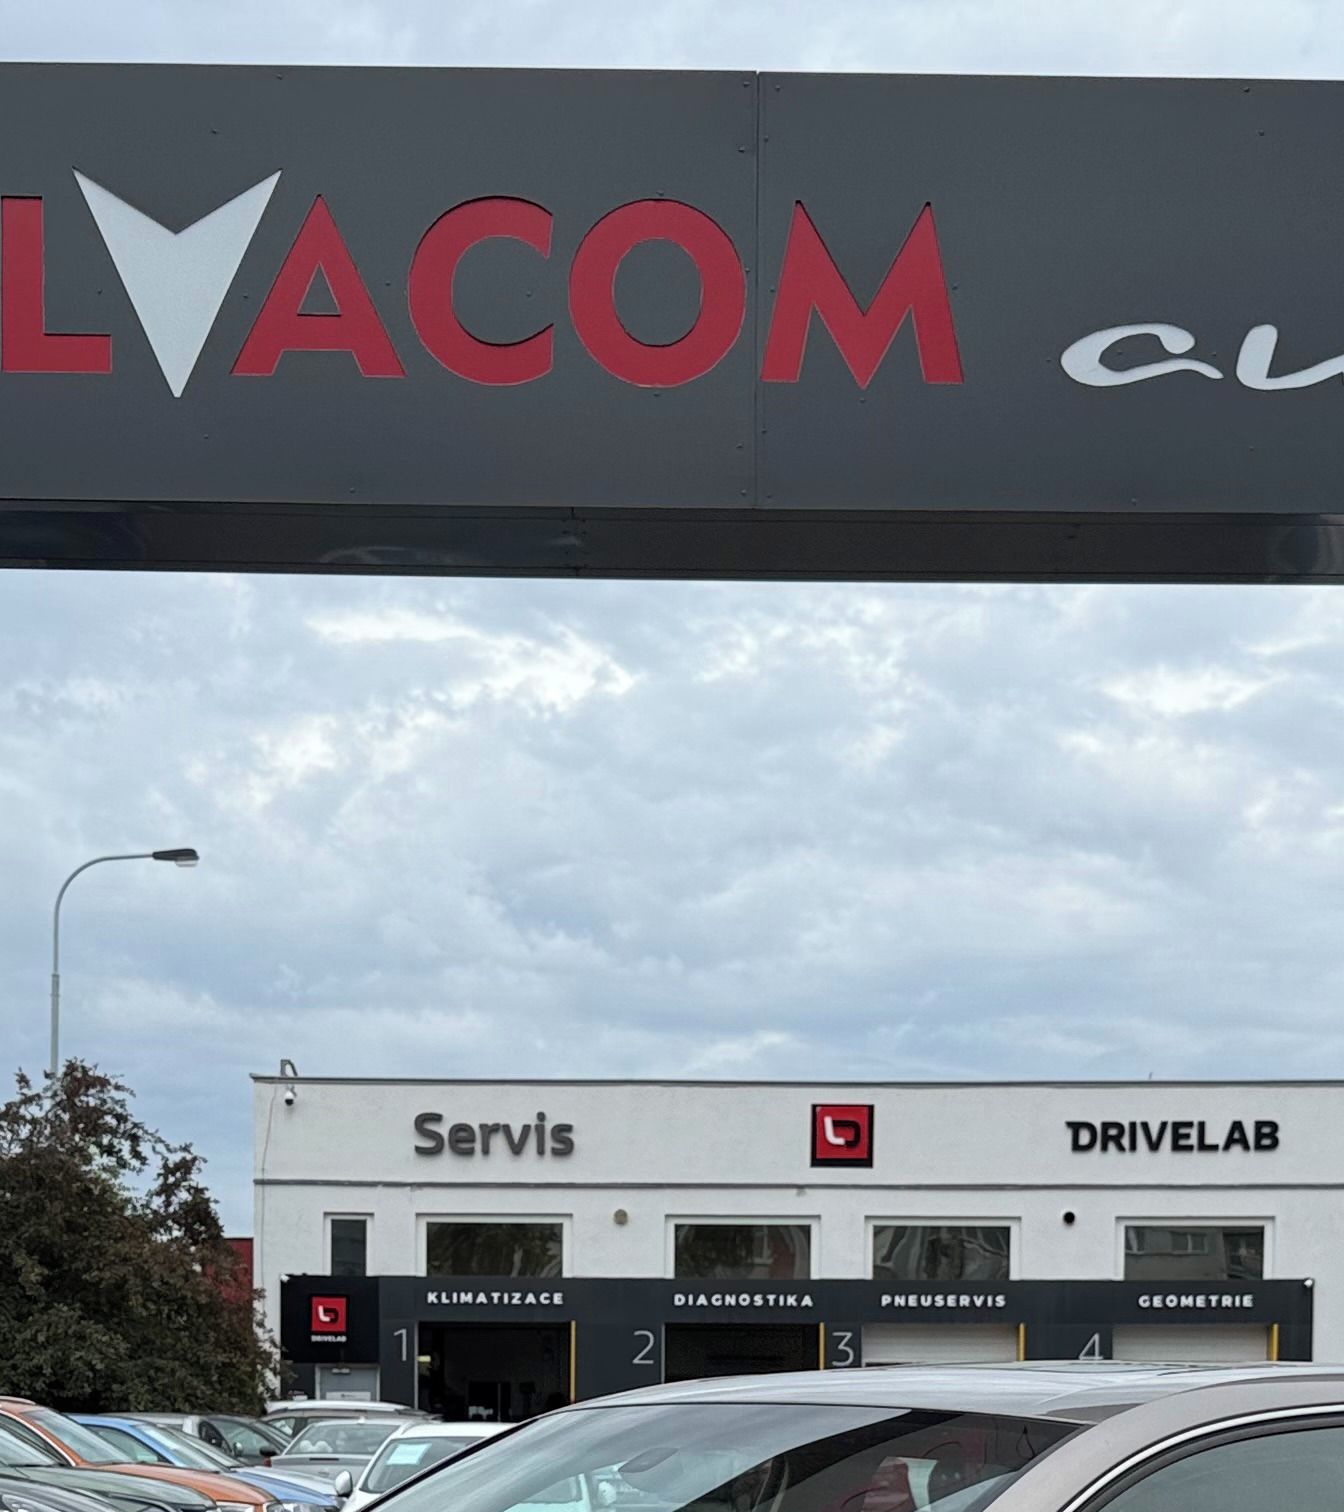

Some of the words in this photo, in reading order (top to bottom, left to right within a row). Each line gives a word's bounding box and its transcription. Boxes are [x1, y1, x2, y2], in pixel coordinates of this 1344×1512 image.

[413, 1111, 575, 1157] Servis
[1065, 1119, 1281, 1154] DRIVELAB
[426, 1291, 564, 1306] KLIMATIZACE
[673, 1292, 814, 1308] DIAGNOSTIKA
[880, 1294, 1007, 1309] PNEUSERVIS
[1138, 1294, 1254, 1309] GEOMETRIE
[393, 1328, 407, 1361] 1
[632, 1330, 655, 1364] 2
[831, 1331, 854, 1367] 3
[1078, 1332, 1104, 1362] 4
